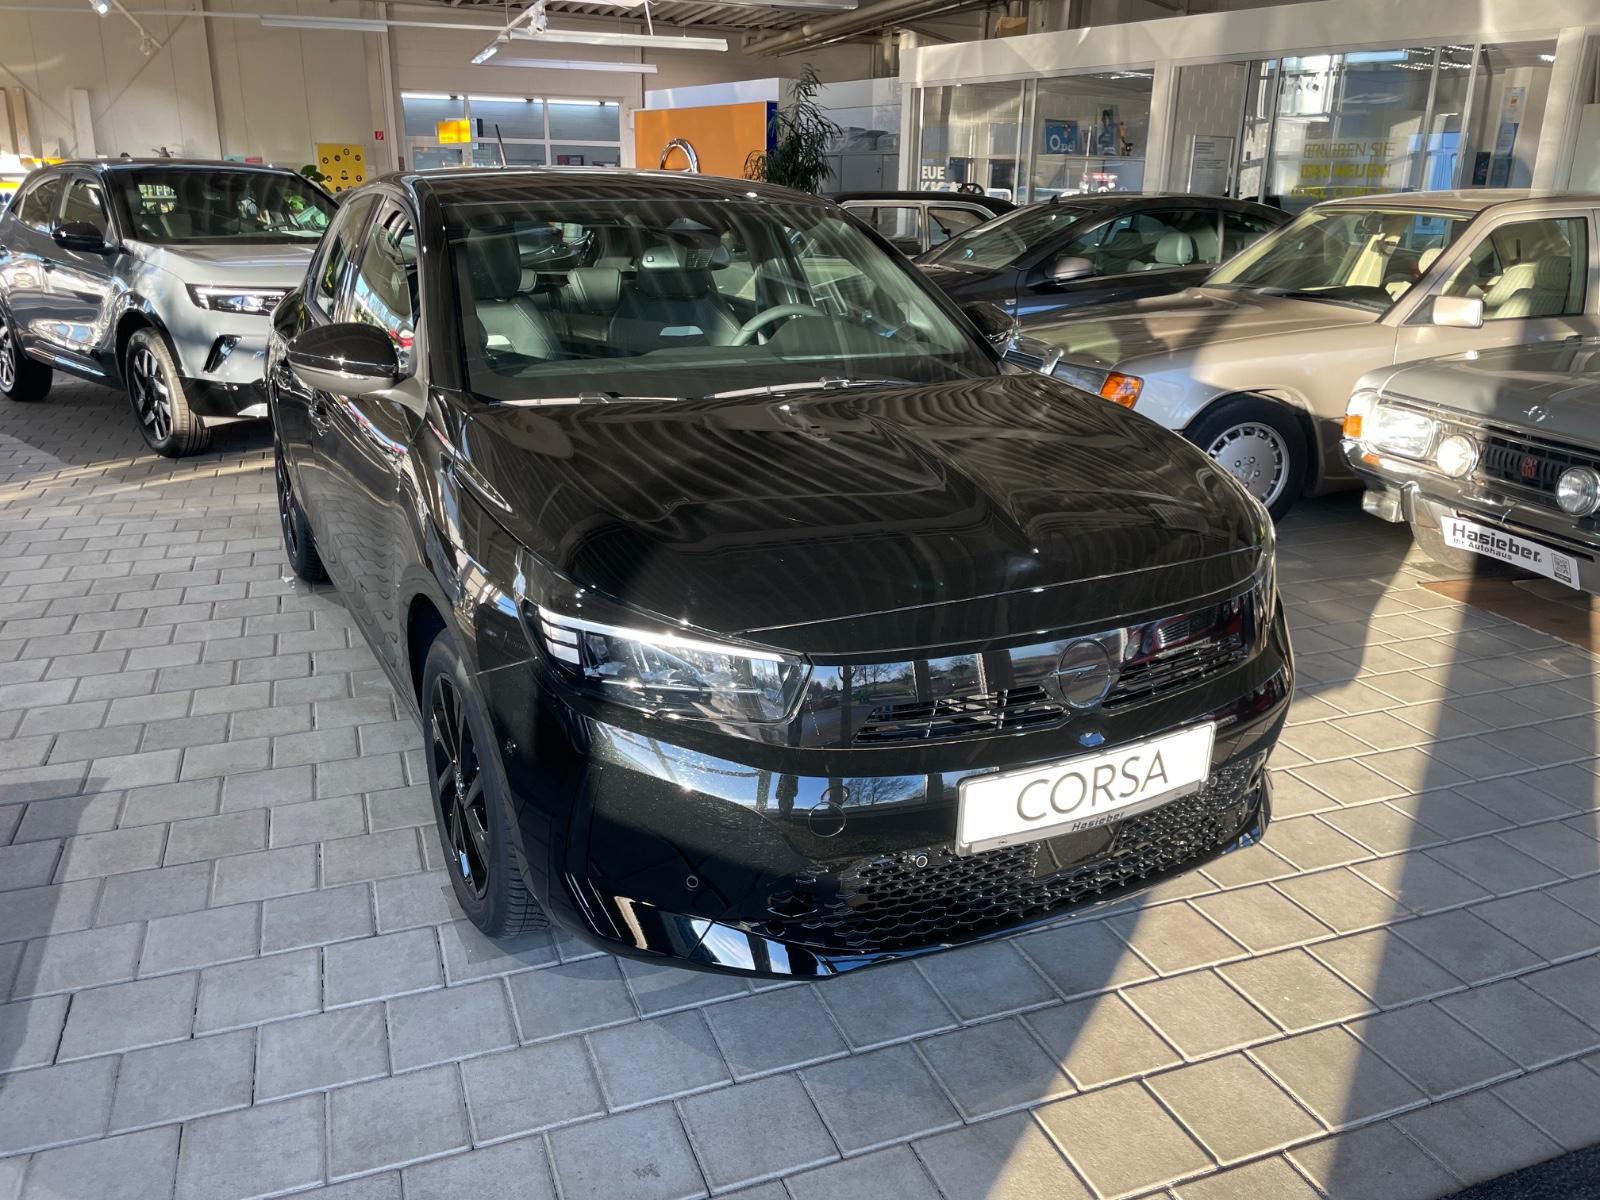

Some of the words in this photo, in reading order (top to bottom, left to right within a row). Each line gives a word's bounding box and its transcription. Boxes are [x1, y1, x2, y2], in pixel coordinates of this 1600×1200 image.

[1049, 134, 1076, 152] Opel
[1468, 541, 1513, 560] Autohaus
[1016, 748, 1169, 821] CORSA
